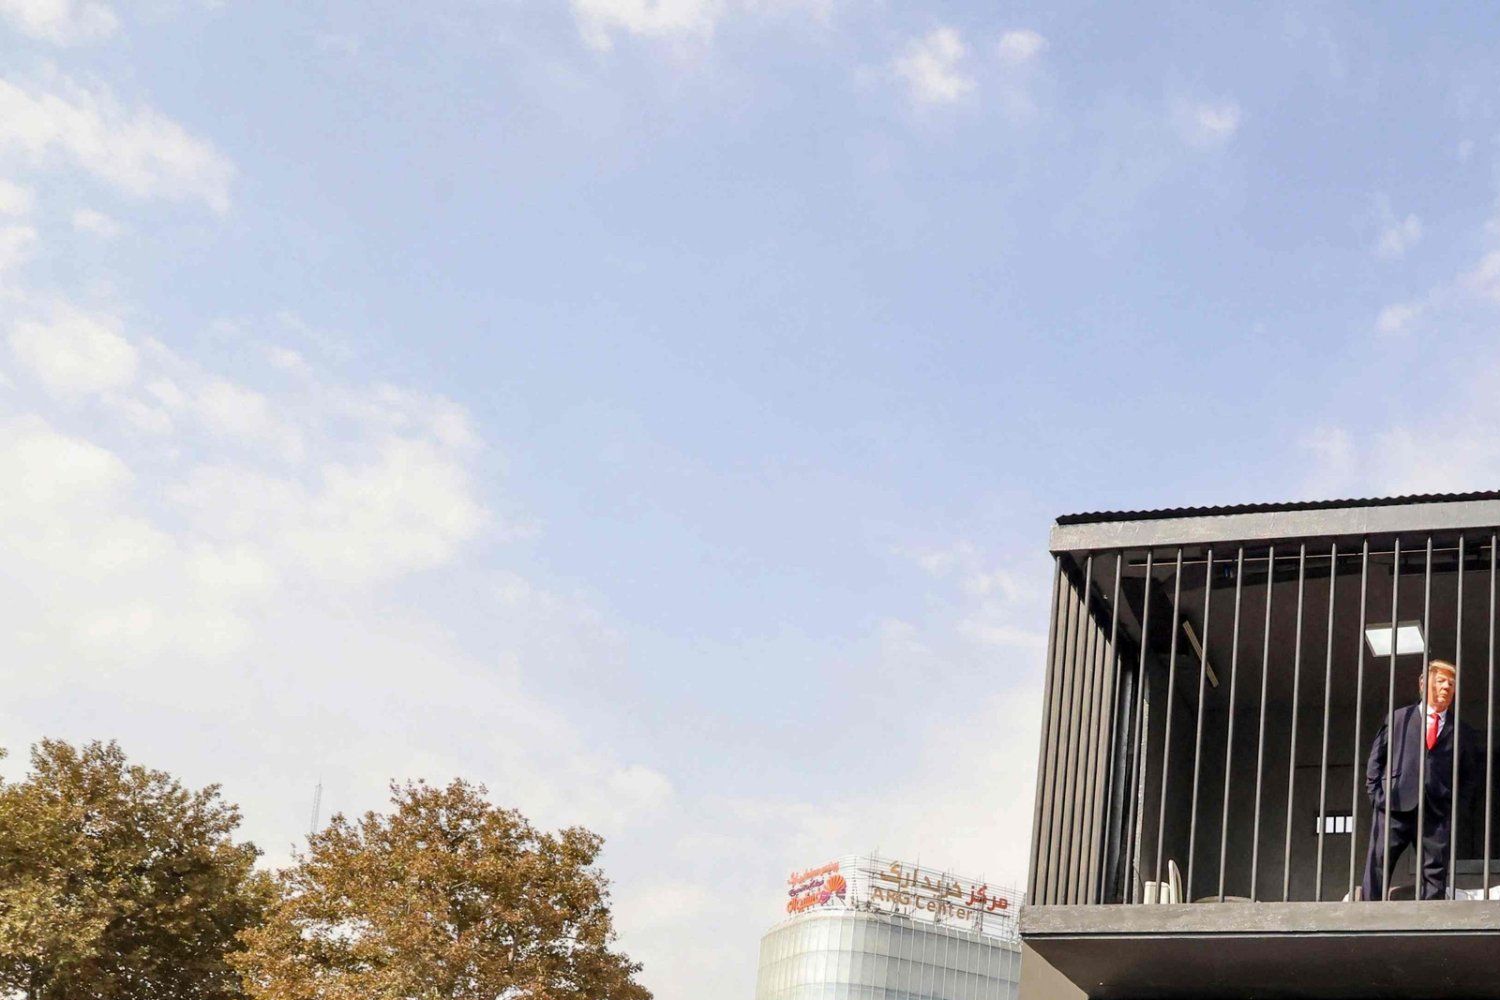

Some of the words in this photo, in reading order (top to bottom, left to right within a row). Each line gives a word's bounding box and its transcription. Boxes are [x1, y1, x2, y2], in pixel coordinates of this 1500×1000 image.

[871, 887, 911, 906] ARG
[915, 895, 973, 921] Center
[965, 883, 1008, 911] مرکز
